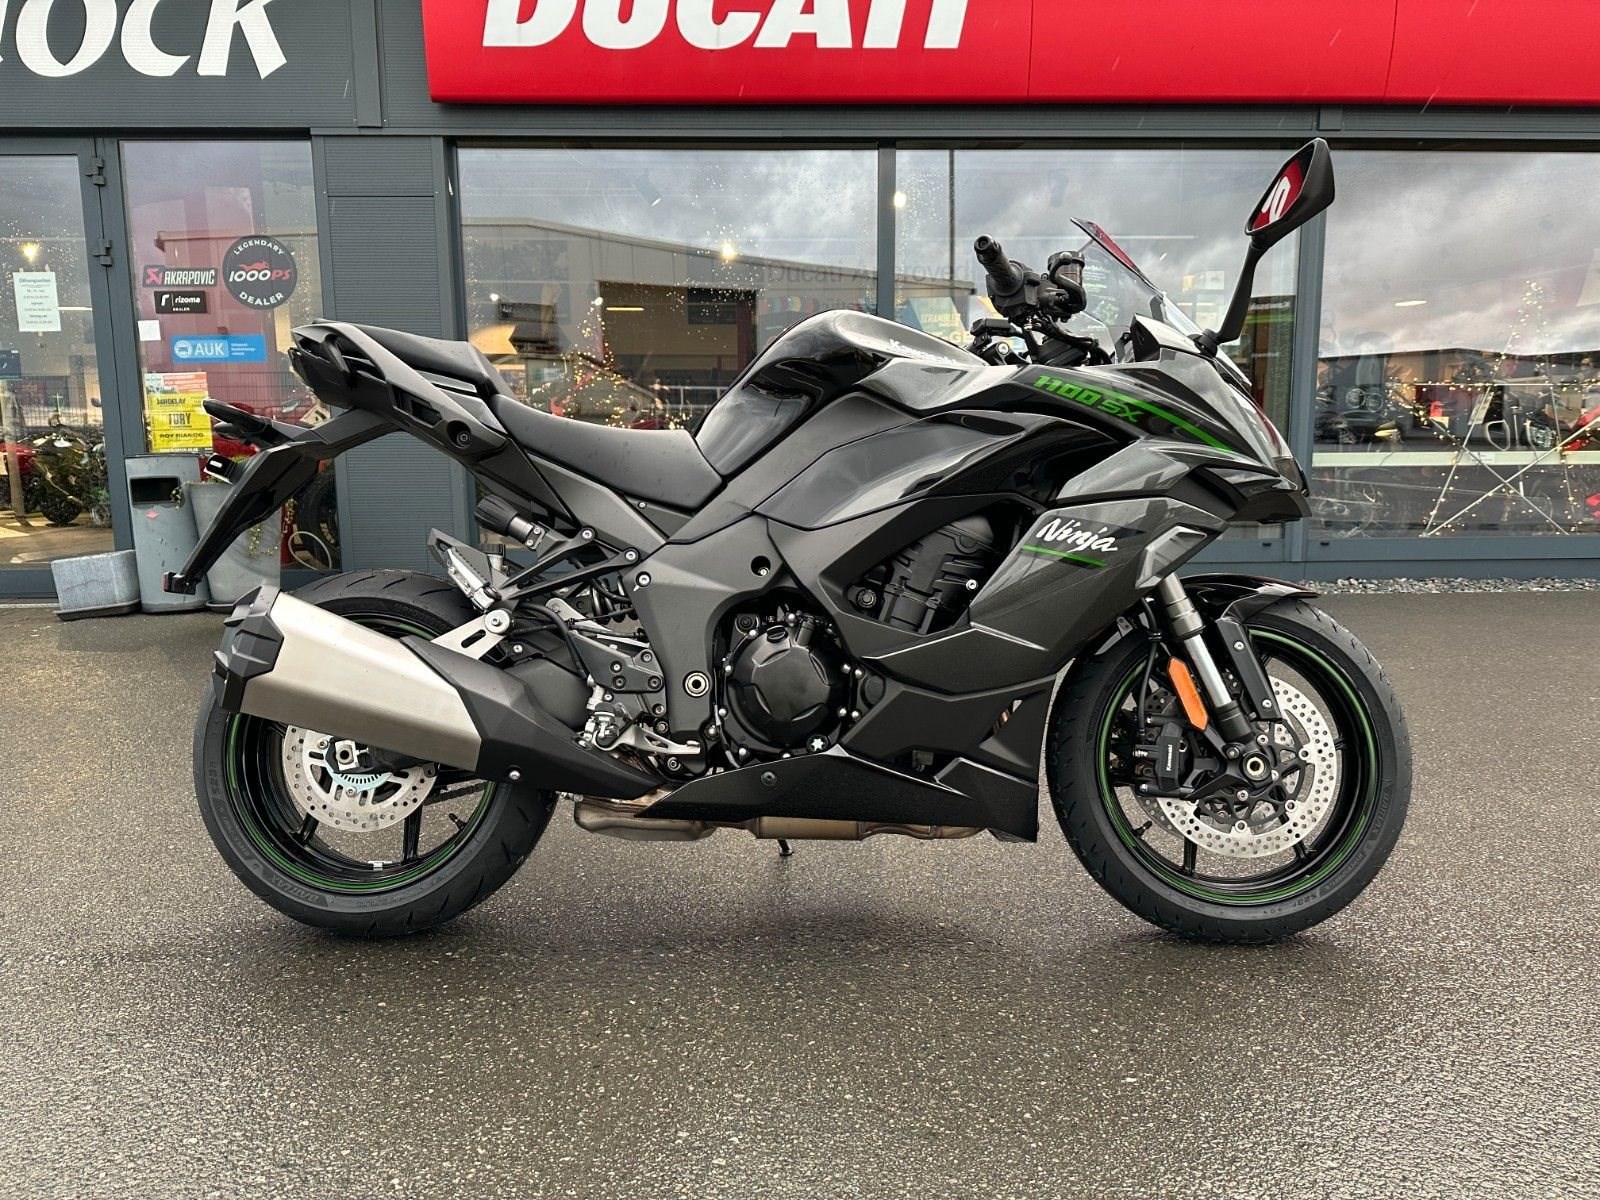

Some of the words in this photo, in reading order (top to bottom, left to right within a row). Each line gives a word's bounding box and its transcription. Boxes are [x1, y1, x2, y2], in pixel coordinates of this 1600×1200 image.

[0, 0, 288, 80] OCK
[233, 239, 285, 255] LEGENDARY
[175, 296, 201, 304] rizoma
[239, 291, 284, 306] DEALER
[1033, 375, 1102, 406] 1100
[1097, 399, 1144, 423] SX
[1035, 518, 1118, 553] Ninja
